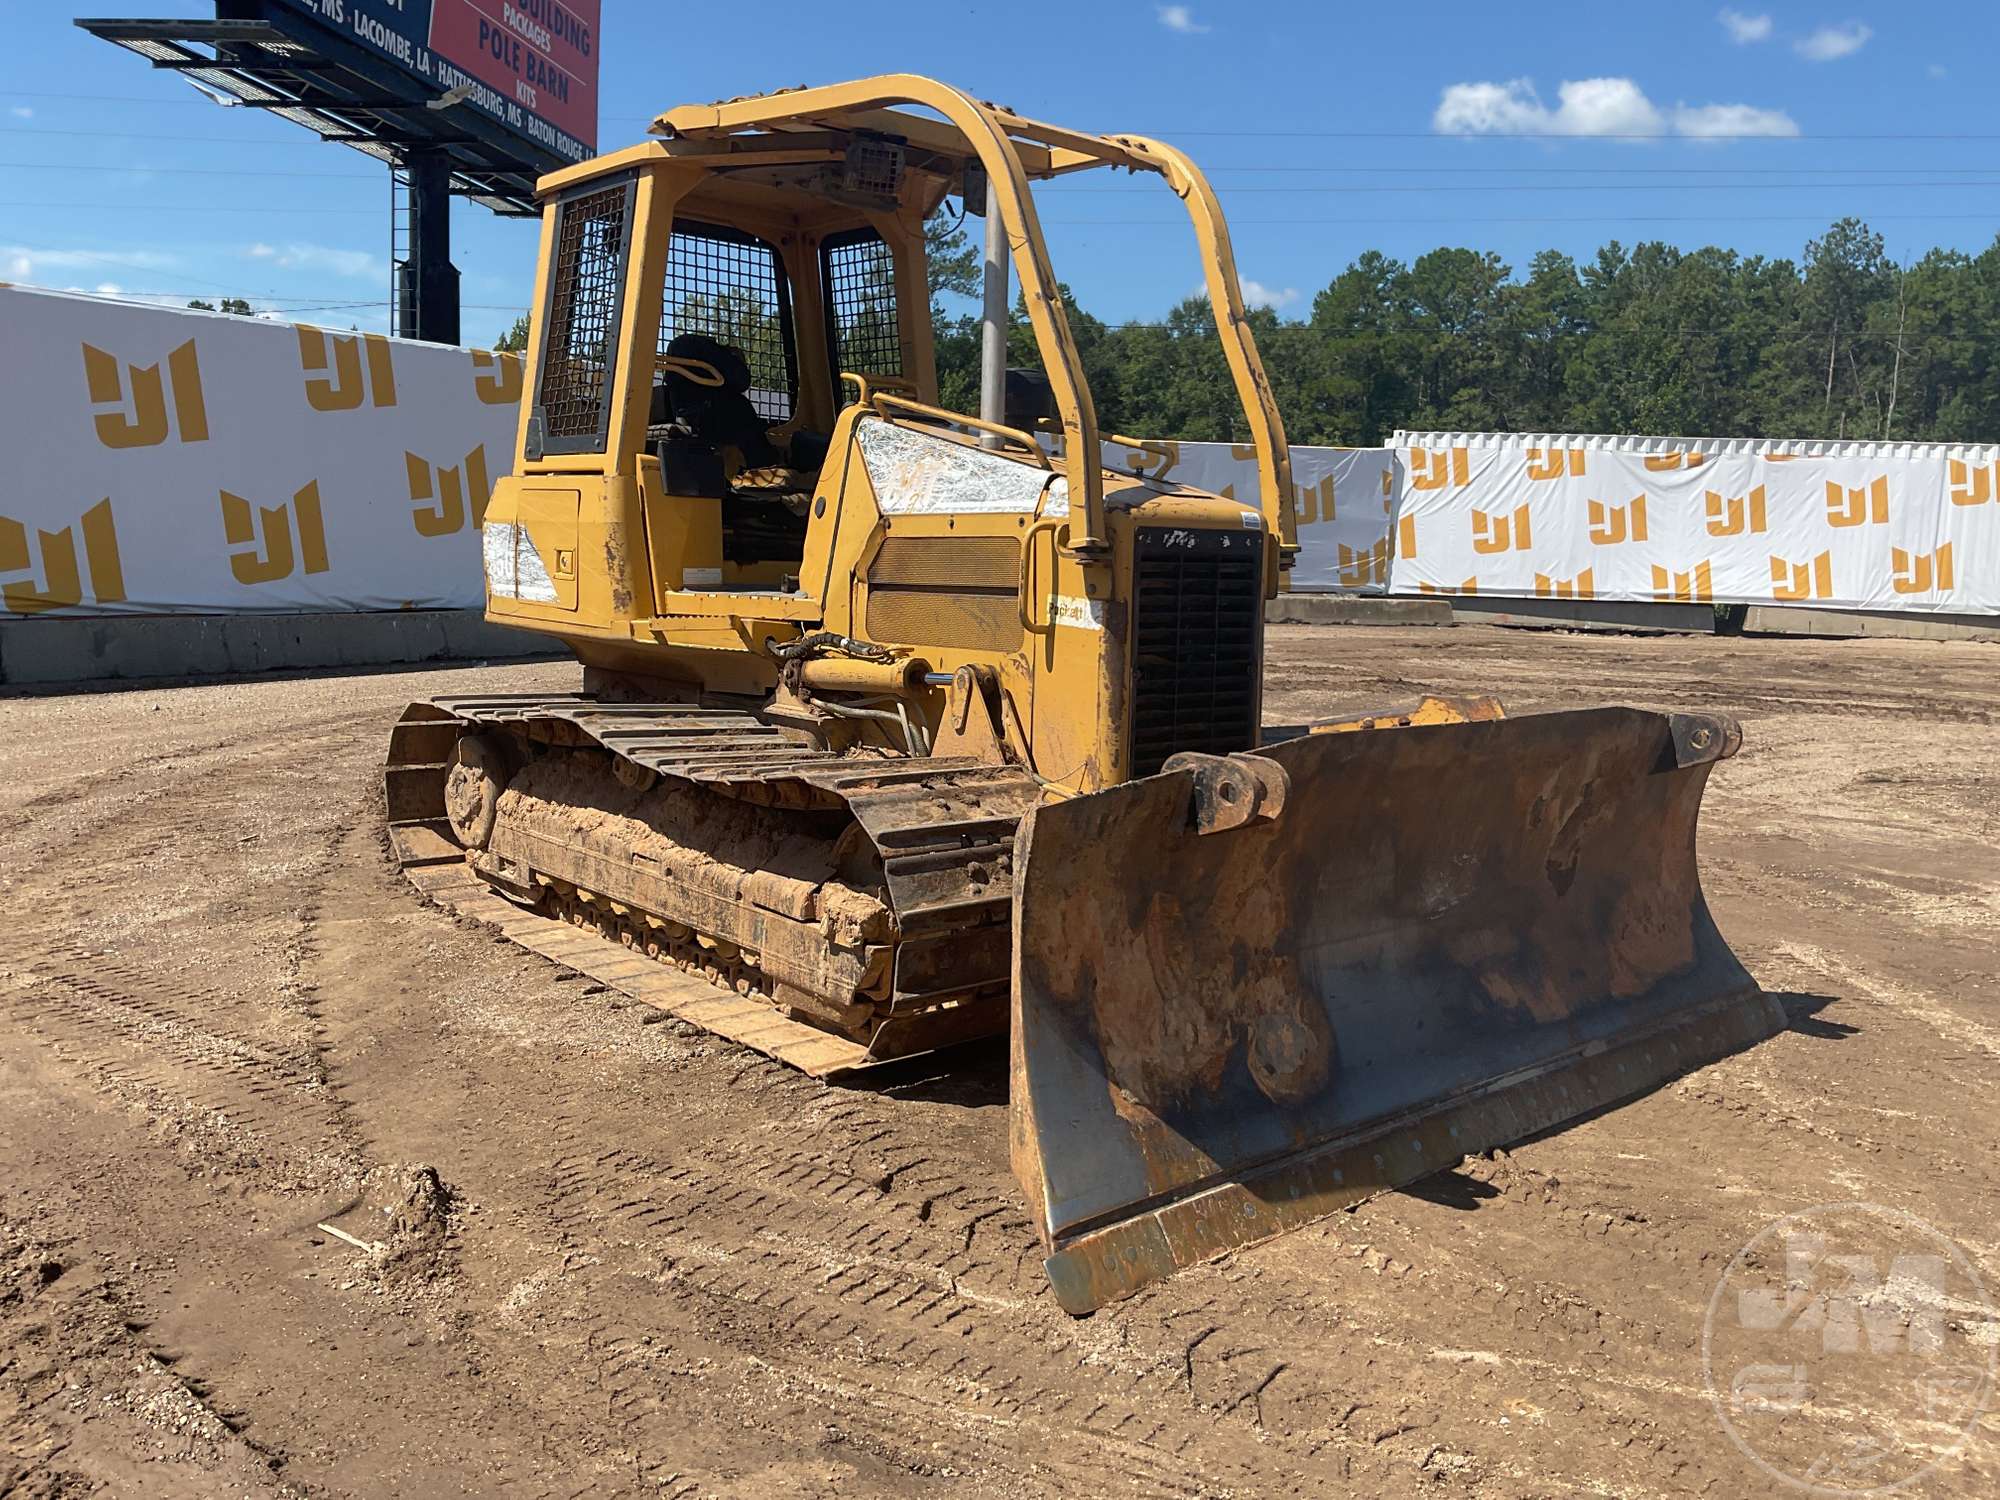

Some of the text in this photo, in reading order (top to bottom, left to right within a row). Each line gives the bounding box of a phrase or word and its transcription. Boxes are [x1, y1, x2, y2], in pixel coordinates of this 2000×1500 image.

[479, 18, 569, 104] POLE BARN
[503, 2, 551, 53] PACKAGES
[354, 9, 414, 70] LACOMBE,
[416, 47, 430, 76] LA
[507, 102, 523, 128] MS
[527, 113, 556, 148] BATON
[516, 79, 537, 109] KITS
